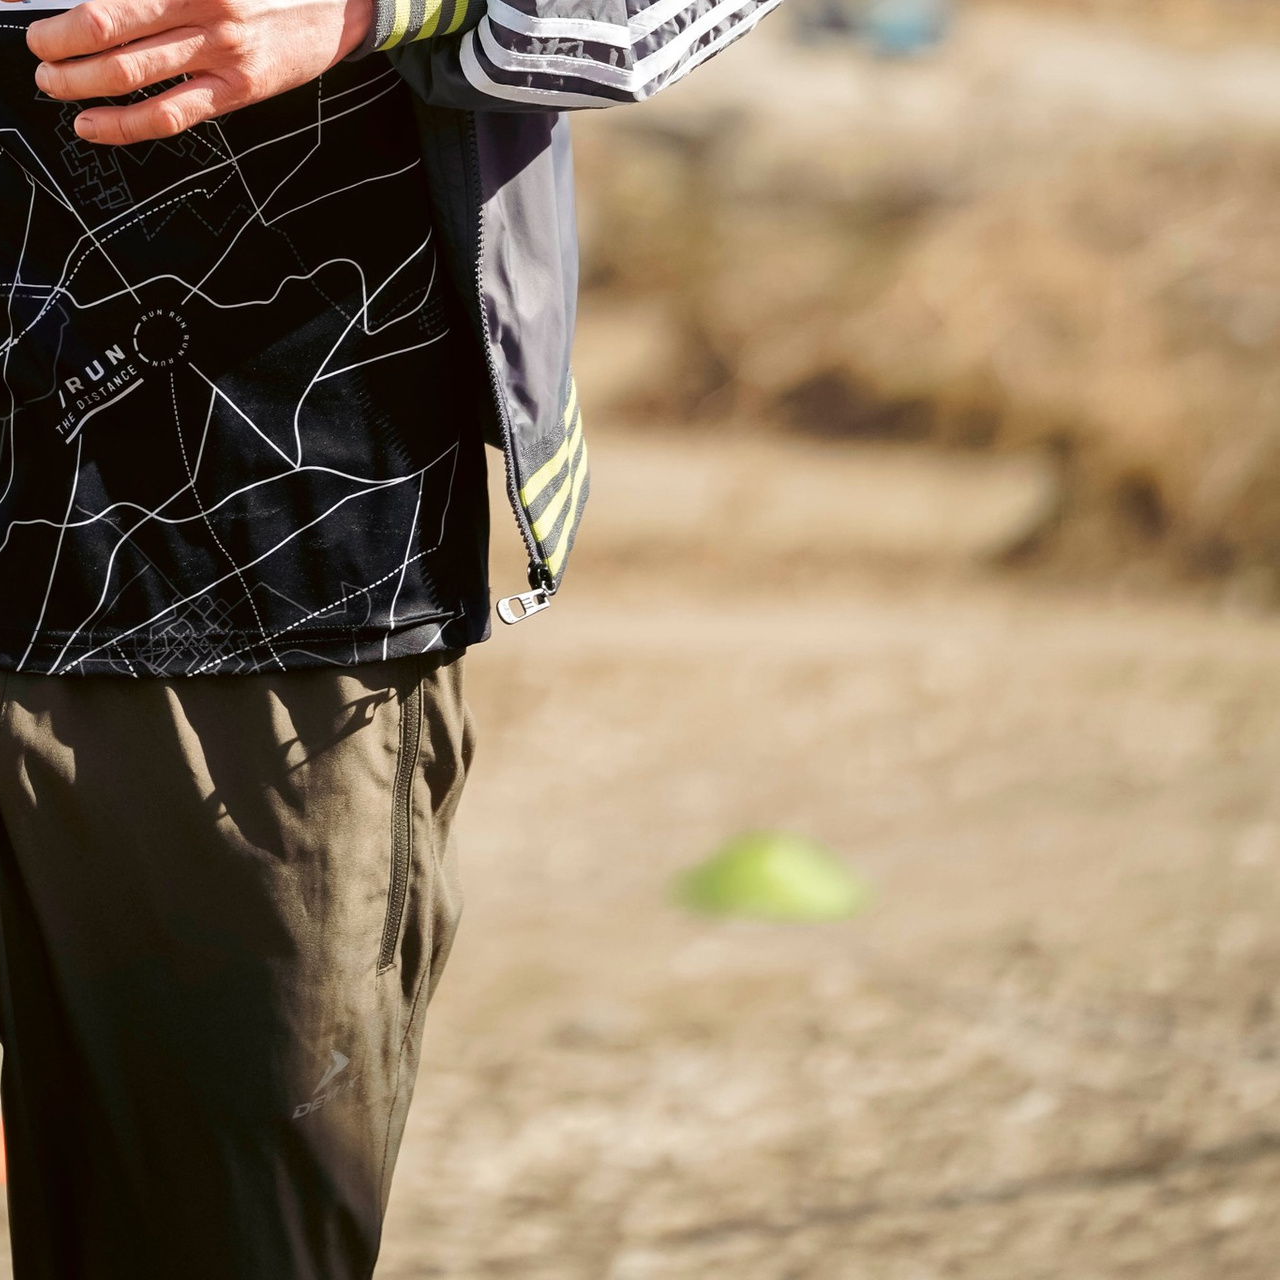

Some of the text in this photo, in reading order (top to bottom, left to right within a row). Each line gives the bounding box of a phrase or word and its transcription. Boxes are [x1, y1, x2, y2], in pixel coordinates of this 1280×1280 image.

[140, 309, 190, 367] RUN RUN RUN RUN
[55, 364, 138, 435] THE DISTANCE
